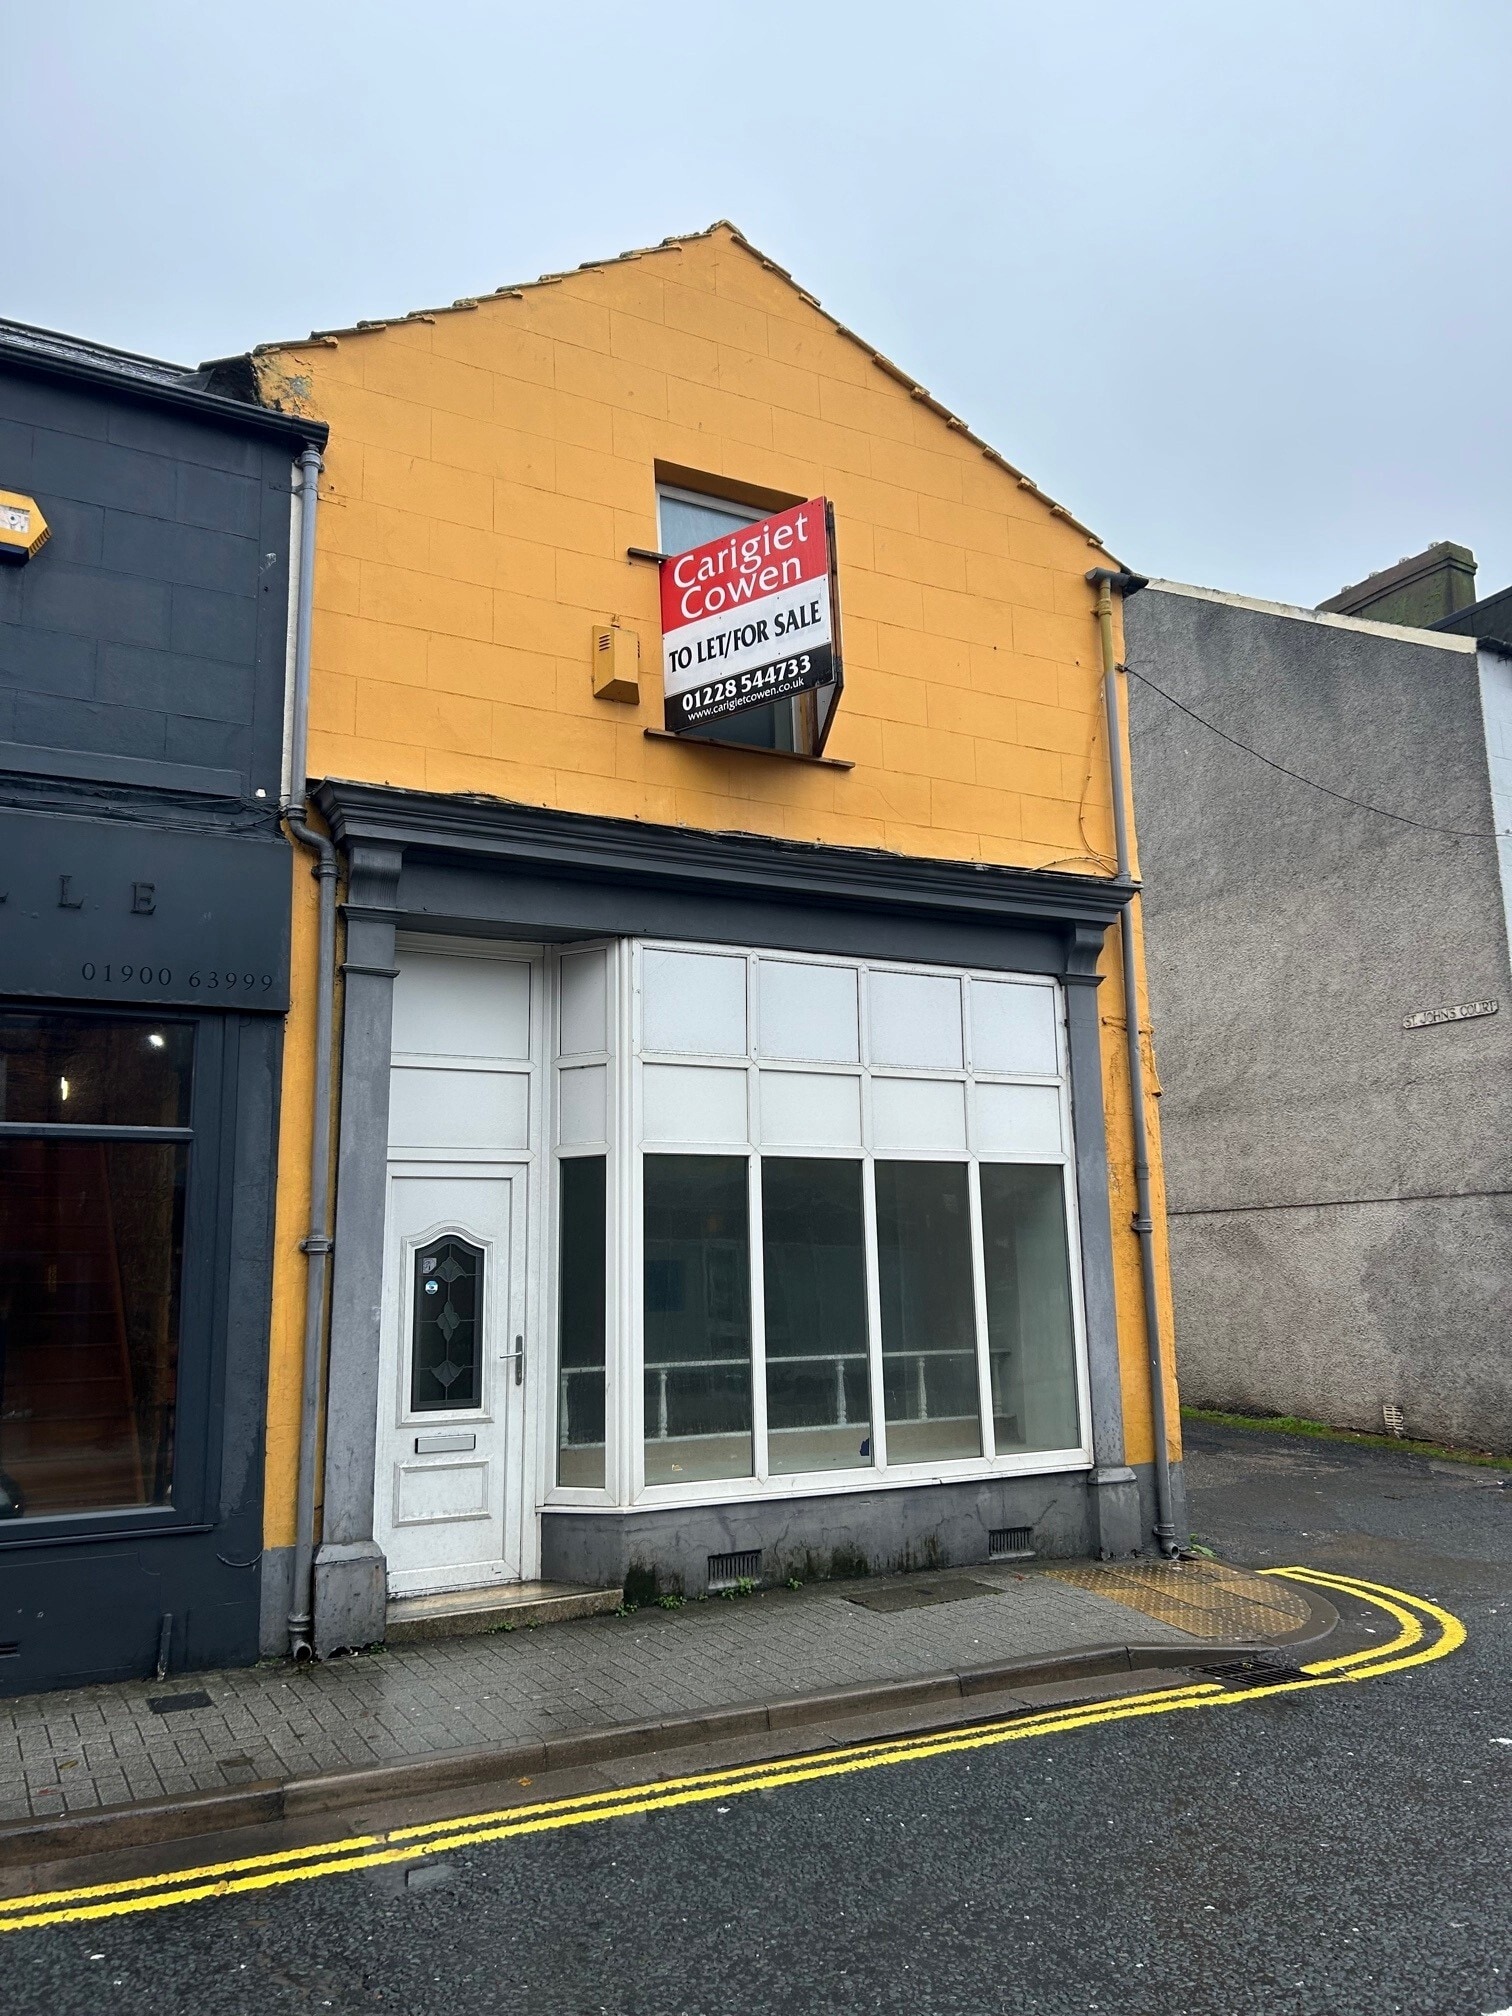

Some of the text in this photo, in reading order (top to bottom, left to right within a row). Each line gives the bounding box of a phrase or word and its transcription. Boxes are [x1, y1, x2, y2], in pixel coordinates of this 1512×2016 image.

[674, 512, 808, 588] Carigiet
[681, 557, 802, 619] Cowen
[669, 600, 822, 673] TO LET/FOR SALE
[682, 654, 812, 711] 01228 544733
[687, 677, 804, 721] www.carigietcowen.co.uk
[0, 875, 157, 915] LE
[82, 962, 273, 992] 01900 63999
[1460, 1000, 1495, 1017] COURT
